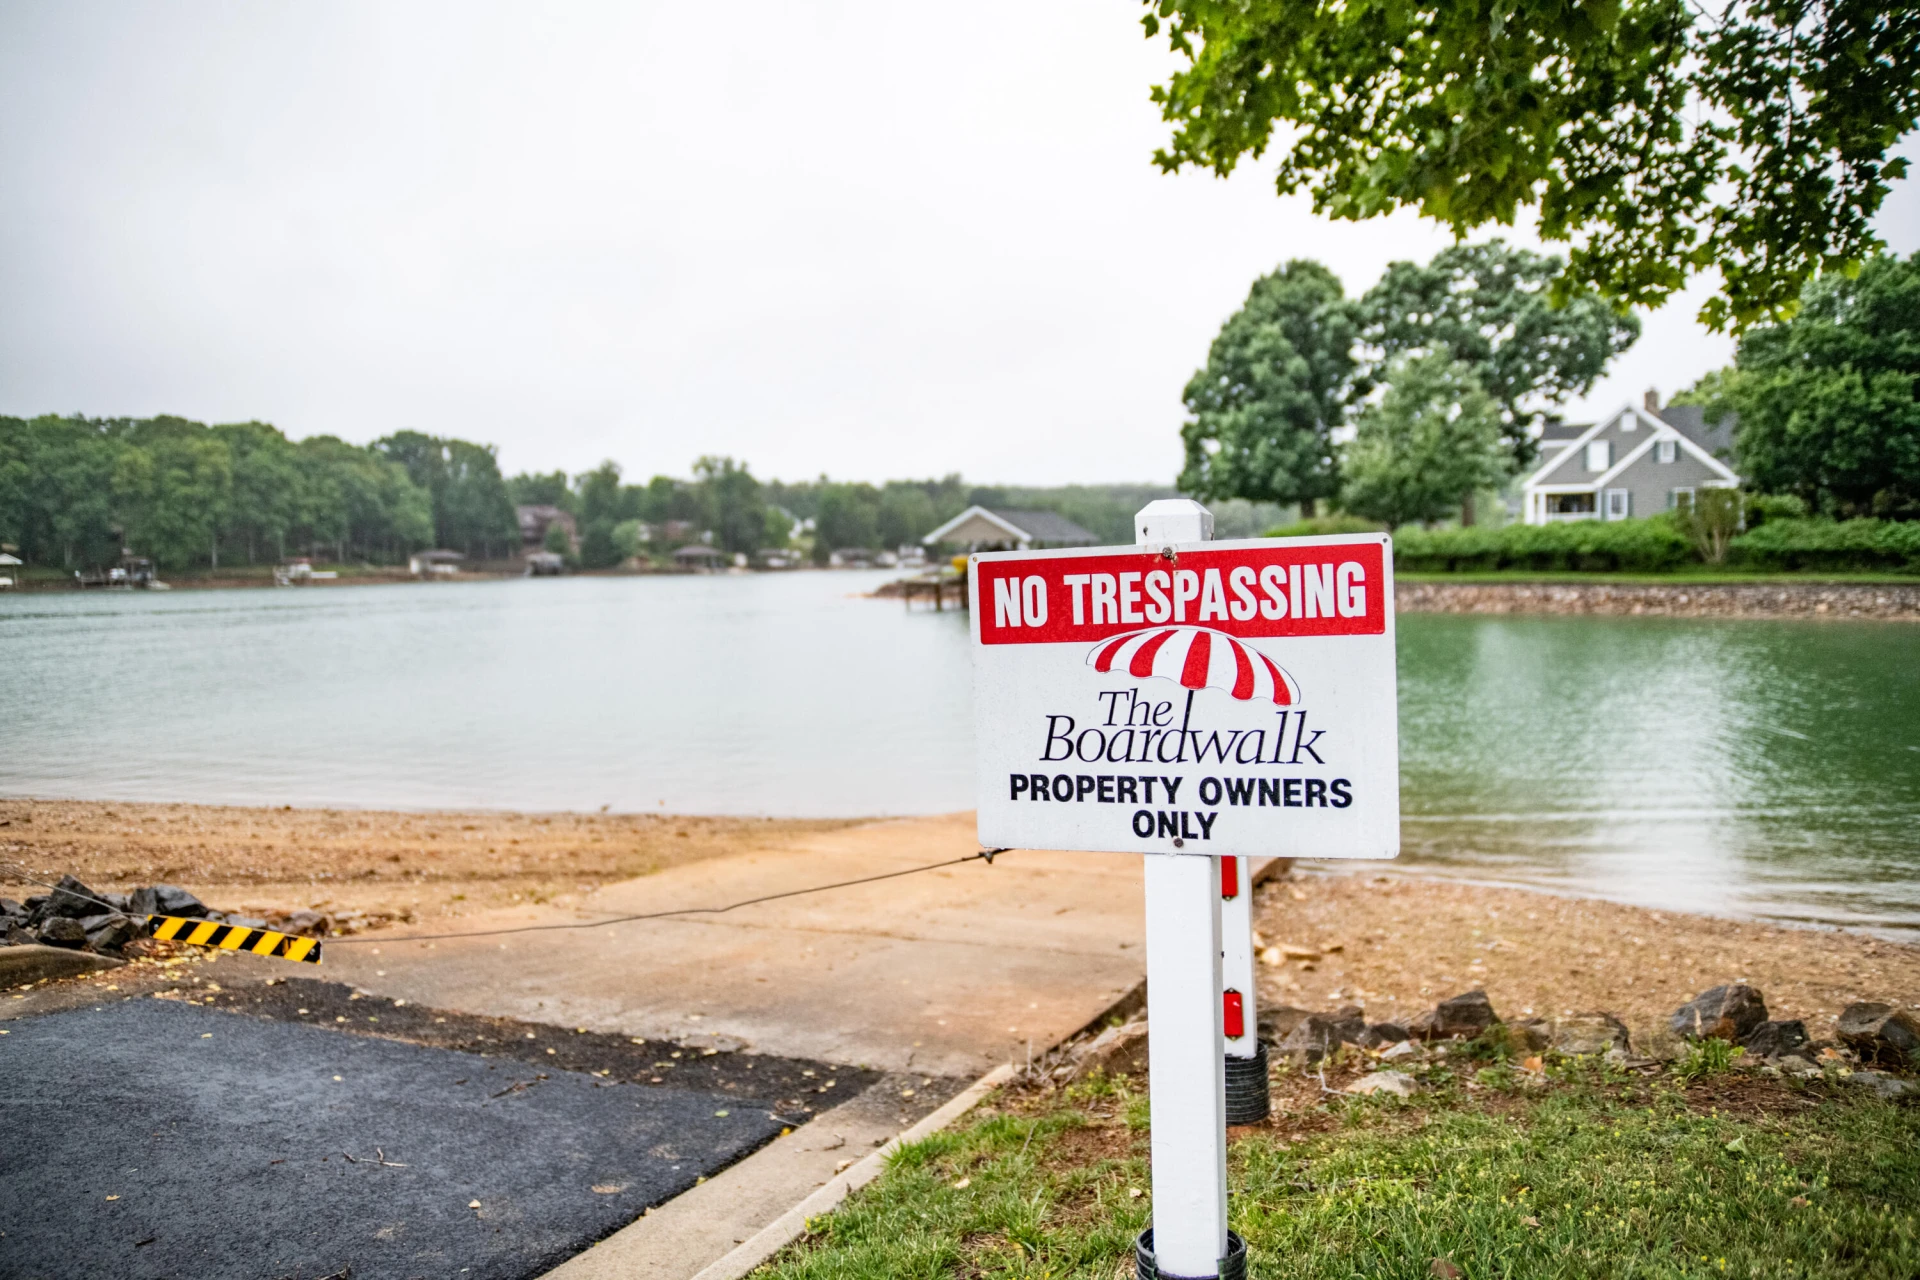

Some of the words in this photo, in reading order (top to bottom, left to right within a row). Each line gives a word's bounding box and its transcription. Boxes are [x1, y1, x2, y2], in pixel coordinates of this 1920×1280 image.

[993, 574, 1048, 628] NO
[1063, 561, 1367, 626] TRESPASSING
[1098, 688, 1174, 727] The
[1039, 710, 1327, 765] Boardwalk
[1009, 773, 1183, 805] PROPERTY
[1199, 777, 1353, 808] OWNERS
[1132, 810, 1218, 840] ONLY
